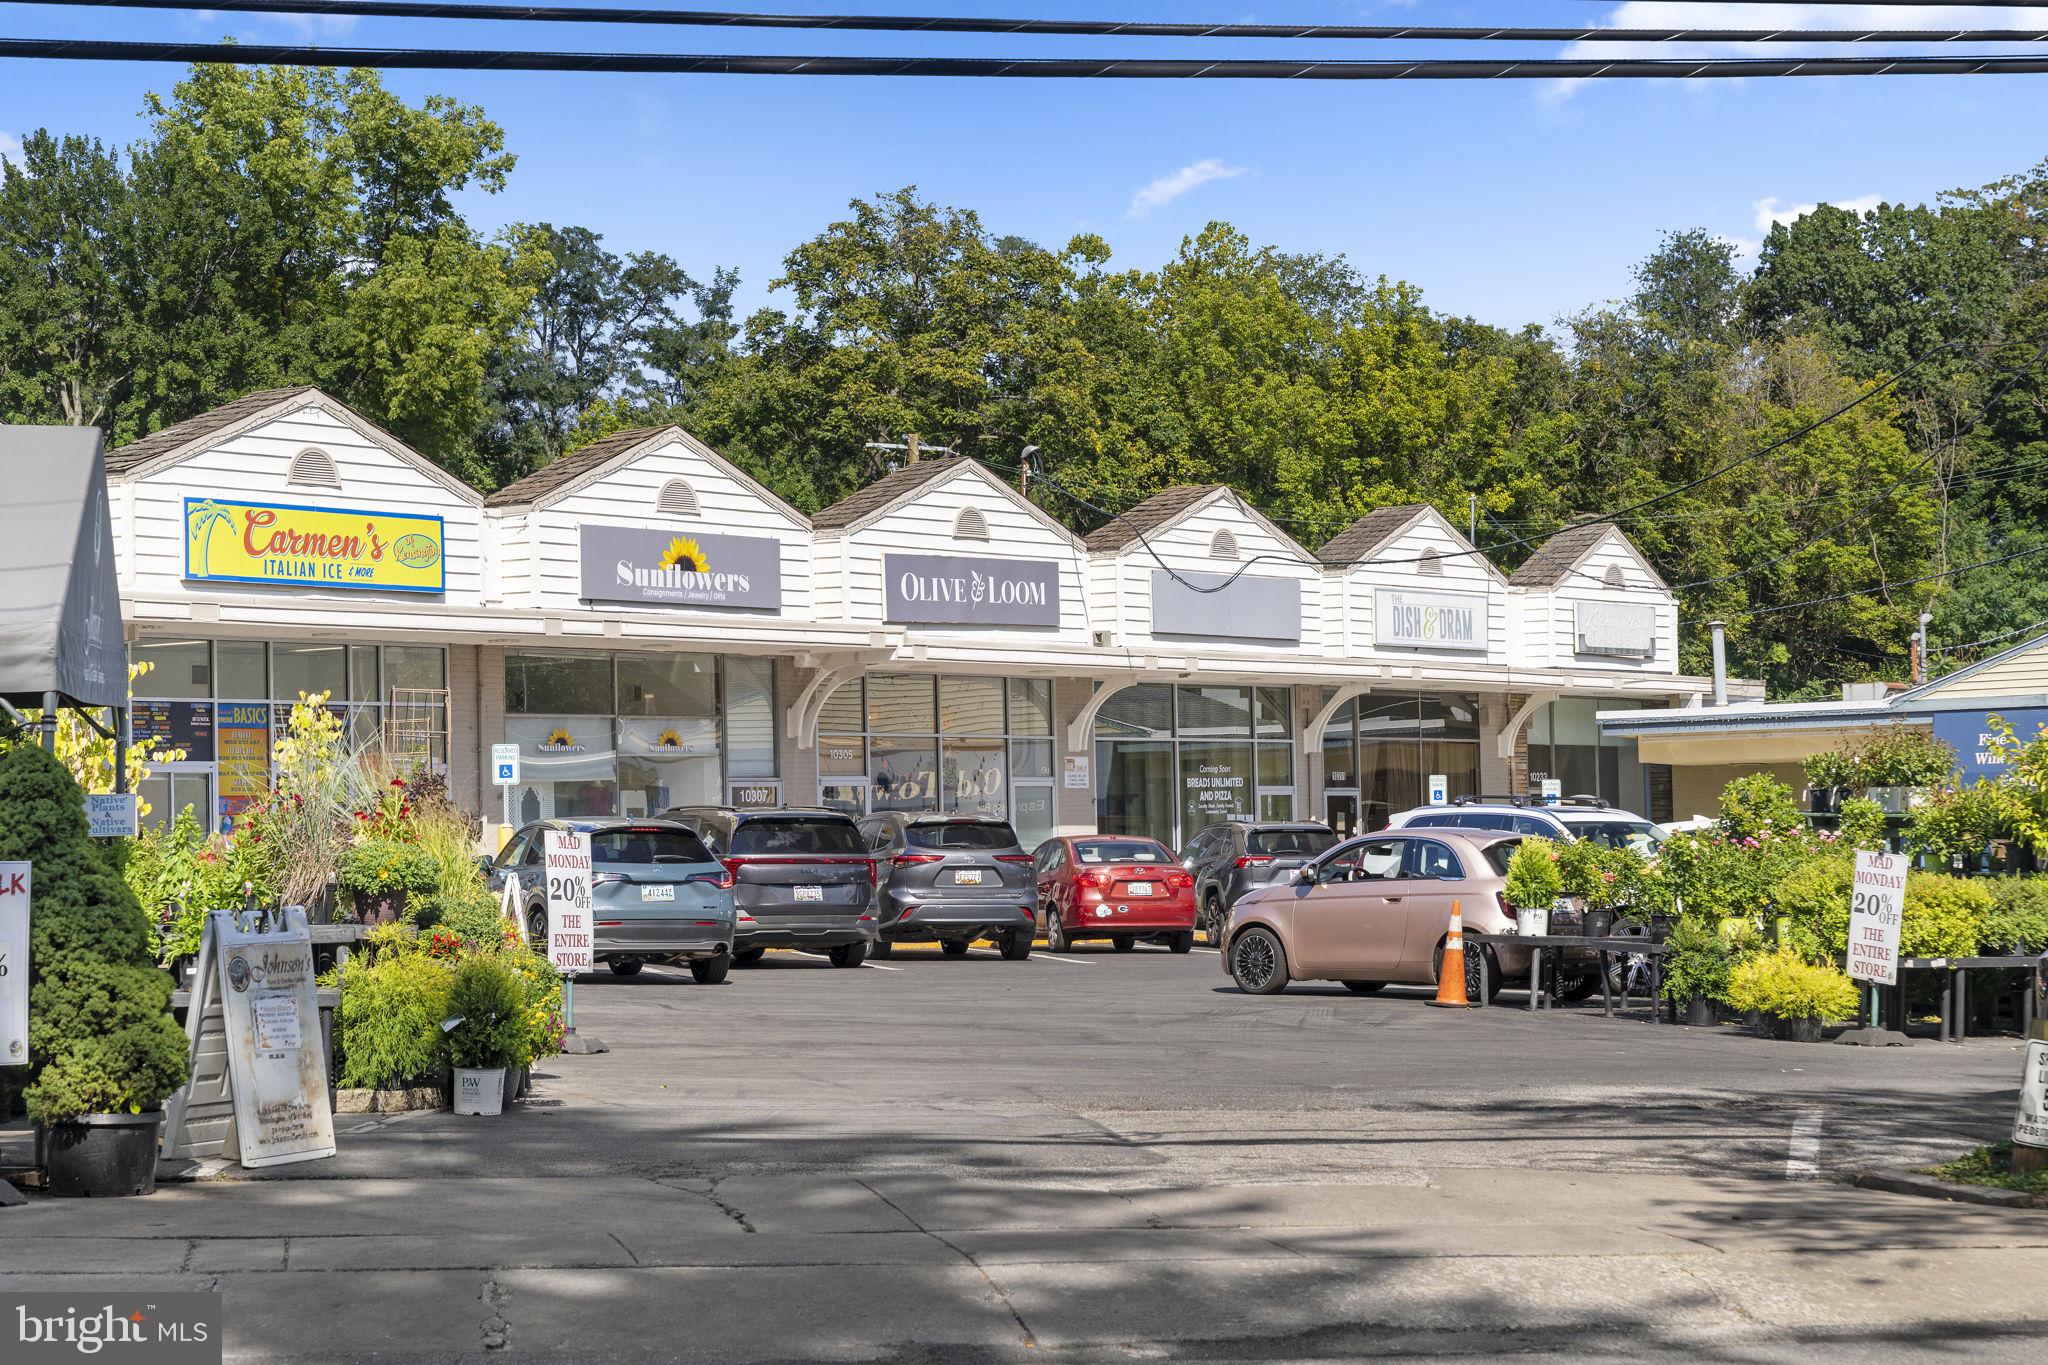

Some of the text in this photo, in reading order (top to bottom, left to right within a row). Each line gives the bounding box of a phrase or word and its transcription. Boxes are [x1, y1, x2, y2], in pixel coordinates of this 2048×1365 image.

[243, 509, 389, 562] Carmen's
[395, 545, 440, 563] Kensington
[264, 559, 316, 577] ITALIAN
[322, 563, 343, 579] ICE
[355, 566, 374, 578] MORE
[616, 559, 750, 593] Sunflowers
[642, 588, 683, 599] Consignments
[687, 591, 709, 600] Jewelry
[713, 592, 726, 600] Gifts
[900, 572, 967, 603] OLIVE
[988, 576, 1046, 606] LOOM
[1391, 594, 1403, 604] THE
[1392, 605, 1473, 641] DISH & DRAM
[233, 707, 267, 724] BASICS
[537, 743, 586, 752] Sunflowers
[648, 744, 694, 752] Sunflowers
[830, 749, 853, 760] 10305
[1199, 764, 1231, 774] Coming Soon
[1186, 777, 1244, 788] BREADS UNLIMITED
[1529, 772, 1548, 782] 10233
[91, 796, 127, 804] Native
[740, 789, 768, 803] 10307
[1200, 790, 1232, 801] AND PIZZA
[92, 803, 125, 811] Plants
[92, 818, 126, 826] Native
[92, 825, 133, 835] ultivars
[558, 836, 580, 849] MAD
[548, 854, 590, 869] MONDAY
[1868, 855, 1893, 870] MAD
[0, 872, 26, 896] LK
[1854, 871, 1903, 889] MONDAY
[550, 876, 586, 901] 20%
[575, 896, 590, 908] OFF
[1854, 893, 1893, 915] 20%
[562, 914, 581, 928] THE
[1879, 912, 1898, 925] OFF
[554, 933, 589, 947] ENTIRE
[1863, 927, 1884, 942] THE
[1853, 943, 1891, 960] ENTIRE
[556, 952, 587, 967] STORE
[251, 951, 311, 983] Johnson's
[1853, 961, 1887, 978] STORE
